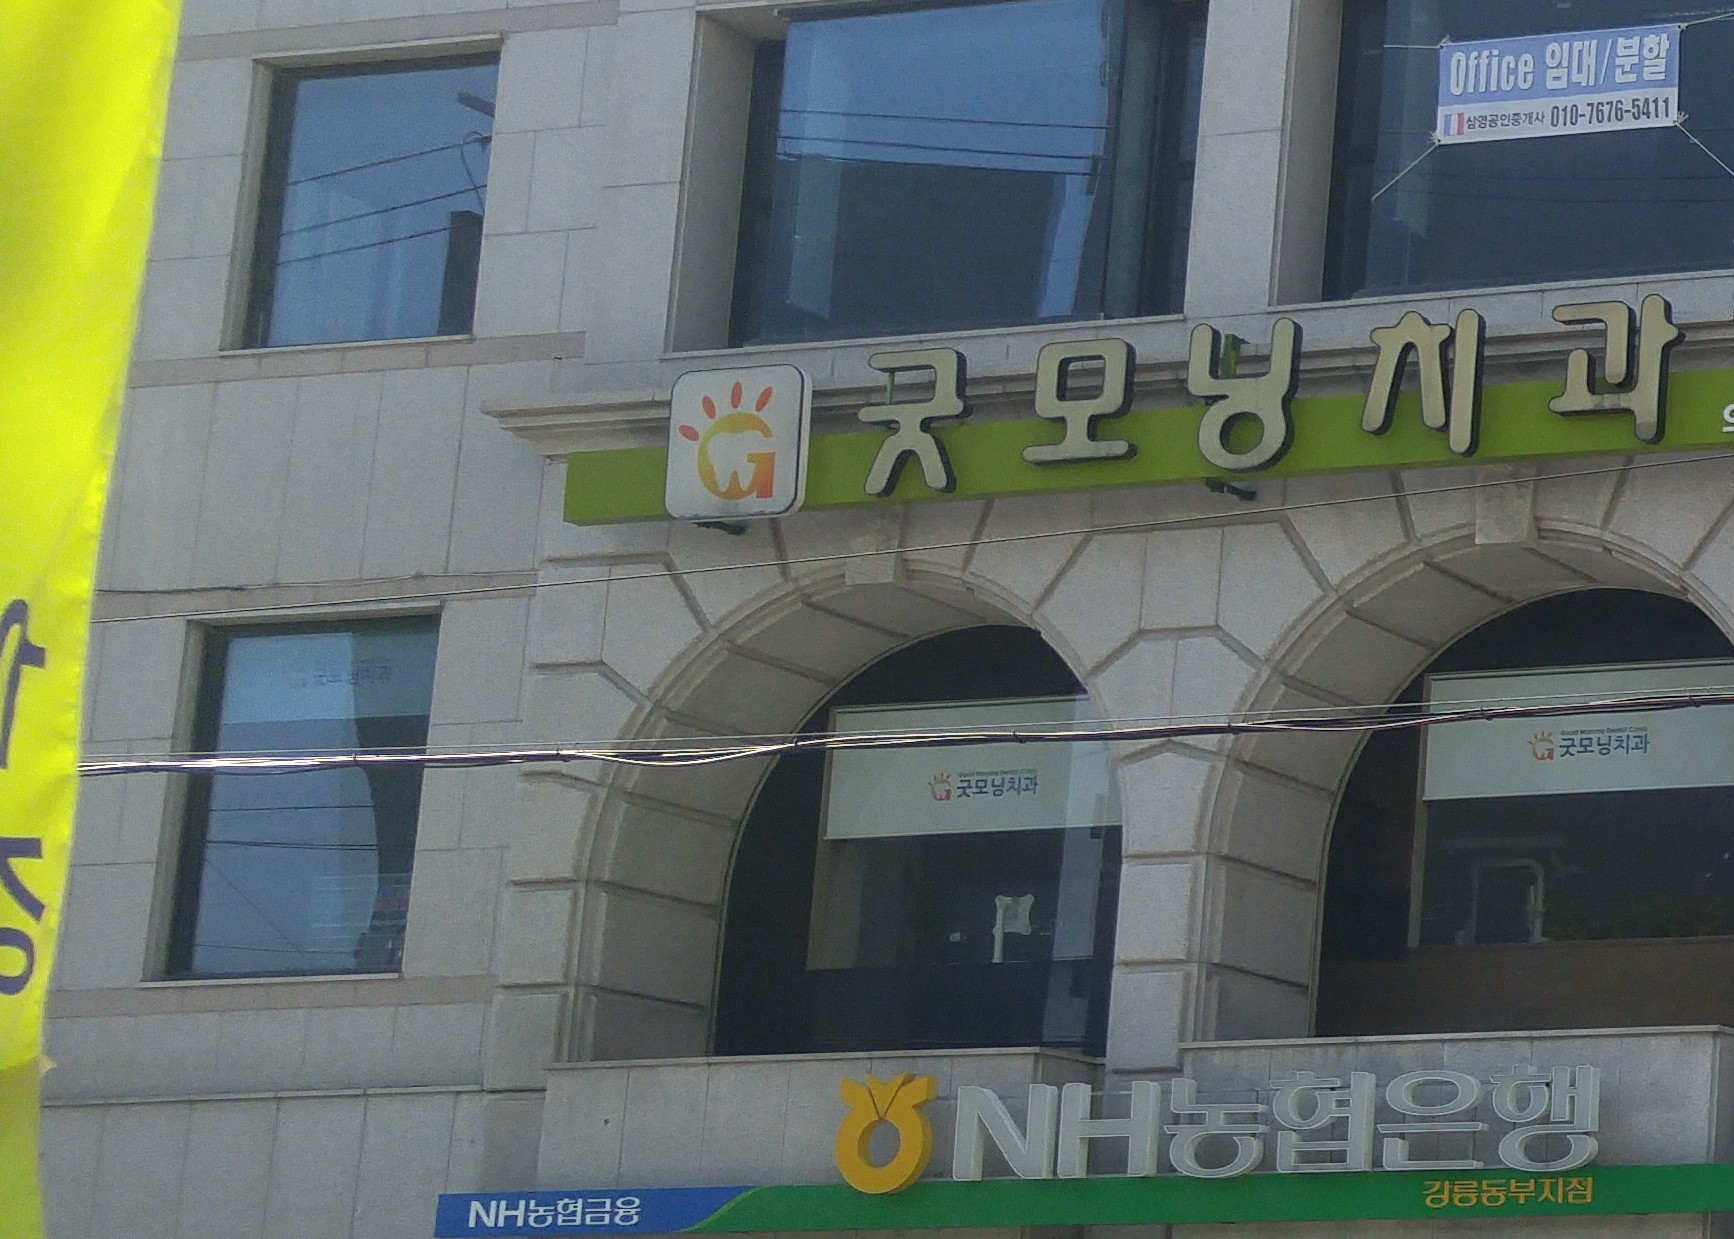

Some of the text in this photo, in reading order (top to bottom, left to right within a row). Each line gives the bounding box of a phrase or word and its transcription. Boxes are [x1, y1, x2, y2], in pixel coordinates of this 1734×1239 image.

[1450, 34, 1671, 96] Office 임대/분할
[1466, 97, 1671, 130] 삼영공인중개사 010-7676-5411
[858, 291, 1686, 497] 굿모닝치과
[1559, 733, 1650, 758] 굿모닝치과
[957, 775, 1039, 798] 굿모닝치과
[951, 1064, 1600, 1182] NH농협은행
[1422, 1177, 1594, 1209] 강릉동부지점
[468, 1196, 642, 1229] NH농협금융
